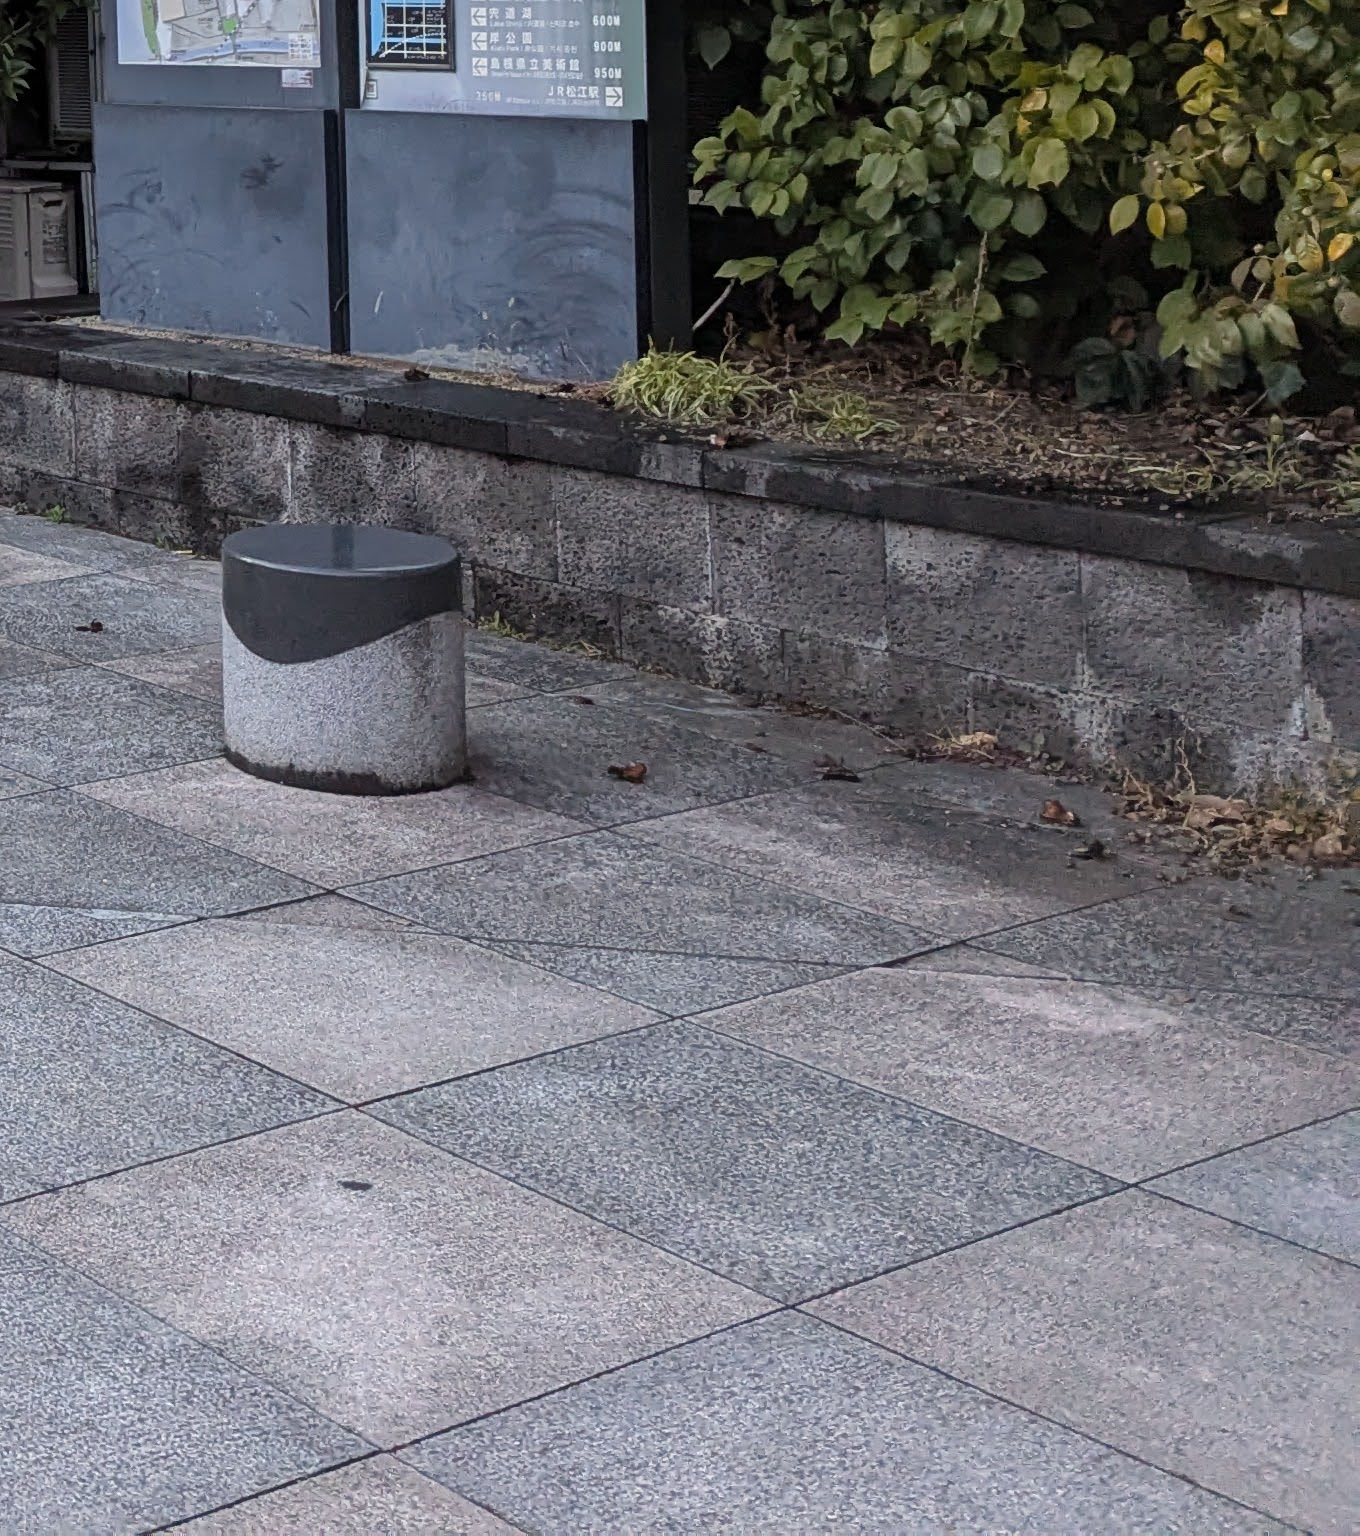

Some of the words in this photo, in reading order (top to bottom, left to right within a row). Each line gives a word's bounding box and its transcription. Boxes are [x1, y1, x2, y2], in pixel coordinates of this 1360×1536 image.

[592, 15, 620, 26] 600M
[490, 31, 532, 44] 岸公園
[593, 40, 621, 52] 900M
[490, 57, 580, 72] 島根県立美術館
[594, 67, 622, 79] 950M
